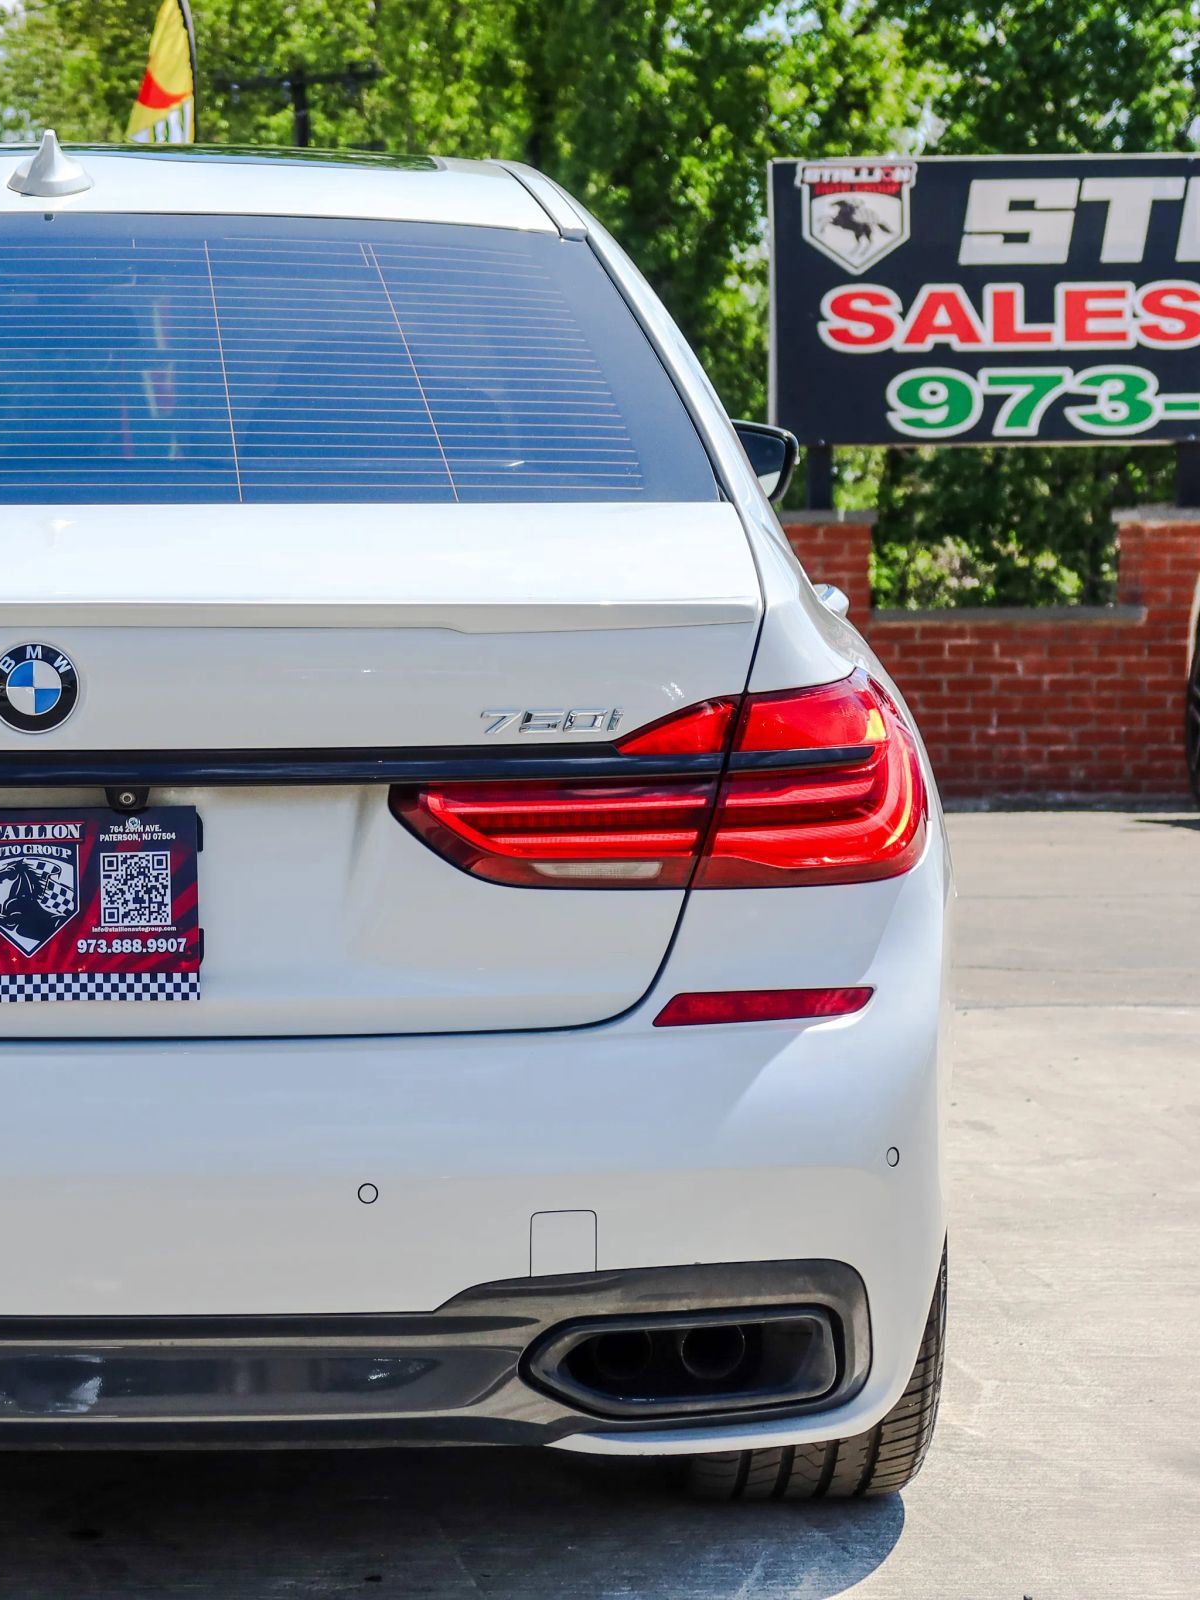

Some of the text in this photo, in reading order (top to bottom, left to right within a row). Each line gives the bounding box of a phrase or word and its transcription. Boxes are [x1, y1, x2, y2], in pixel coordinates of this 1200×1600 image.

[817, 280, 1200, 353] SALES
[480, 708, 625, 734] 750i
[145, 824, 162, 832] AVE.
[100, 833, 141, 842] PATERSON,
[152, 832, 176, 840] 07504
[22, 844, 72, 859] GROUP
[77, 938, 187, 953] 973.888.9907
